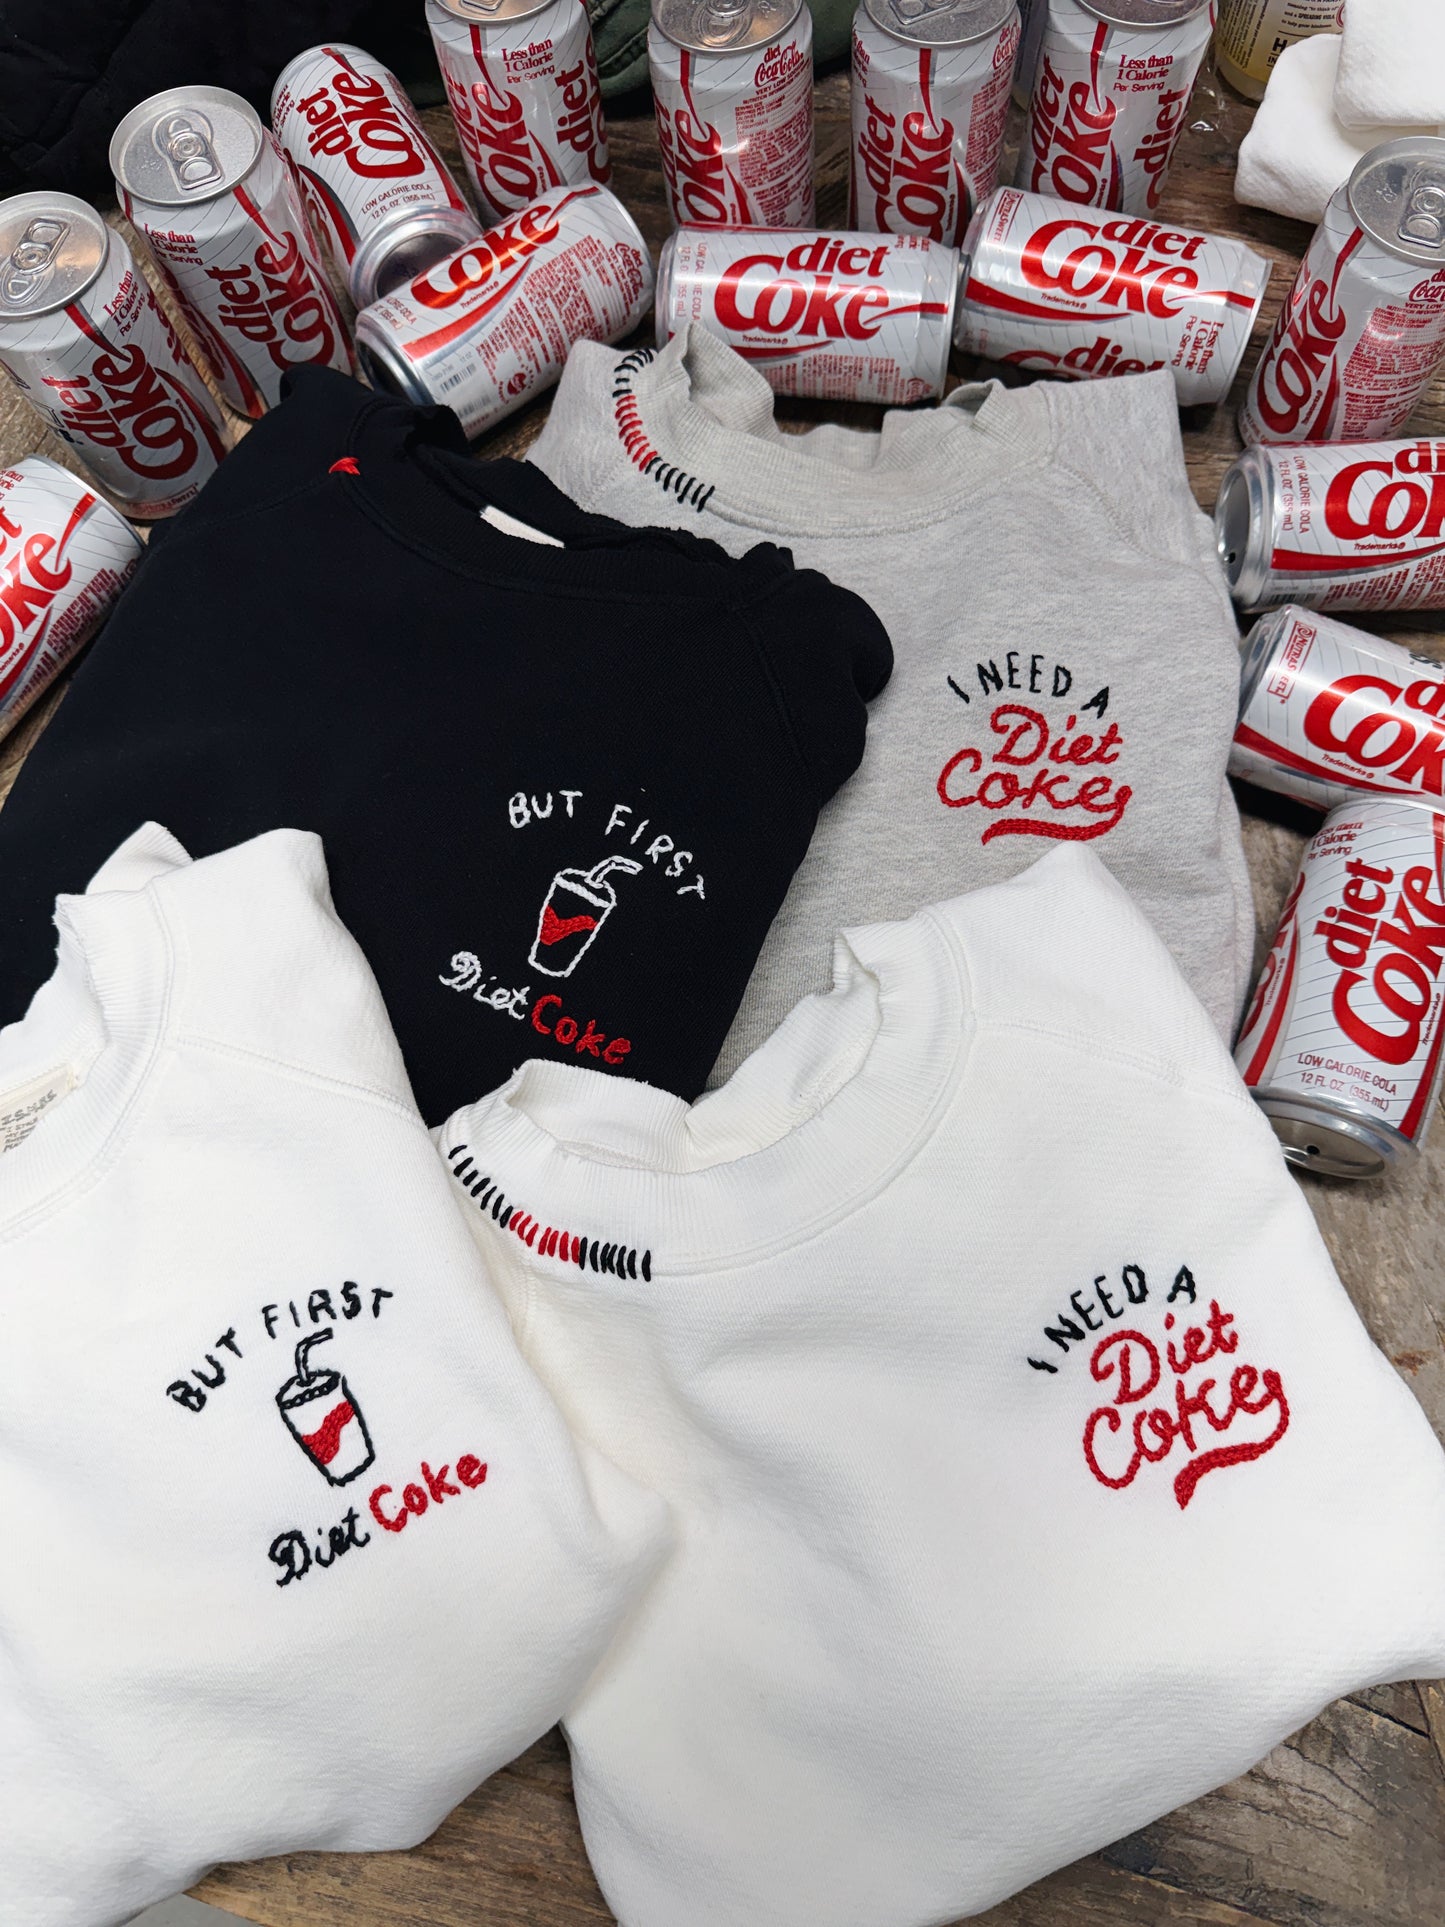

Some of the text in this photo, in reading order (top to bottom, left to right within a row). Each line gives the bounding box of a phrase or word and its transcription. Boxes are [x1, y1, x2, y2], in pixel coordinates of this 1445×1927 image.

[502, 39, 553, 63] Less than
[505, 51, 554, 73] 1 Calorie
[507, 64, 556, 84] Per Serving
[764, 43, 781, 64] diet
[1116, 67, 1169, 81] 1 Calorie
[1119, 54, 1173, 69] Less than
[557, 60, 593, 154] diet
[1113, 81, 1165, 92] Per Serving
[296, 88, 353, 158] diet
[332, 72, 425, 179] Coke
[858, 94, 897, 192] diet
[1133, 83, 1189, 174] diet
[362, 184, 432, 214] LOW CALORIE COLA
[371, 211, 380, 219] 12
[144, 223, 196, 243] Less than
[157, 239, 199, 254] Calorie
[171, 253, 204, 266] Serving
[410, 204, 560, 309] Coke
[787, 237, 891, 278] diet
[1091, 217, 1208, 261] diet
[103, 270, 134, 318] Less than
[118, 281, 139, 321] Calorie
[692, 259, 705, 295] CALIE
[714, 254, 890, 341] Coke
[1020, 219, 1199, 319] Coke
[119, 321, 132, 337] Per
[207, 264, 274, 343] diet
[255, 231, 335, 373] Coke
[692, 298, 705, 320] COLA
[1185, 327, 1209, 370] Calorie
[1197, 320, 1224, 374] Less than
[1256, 279, 1346, 424] Coke
[41, 374, 127, 448] diet
[92, 344, 199, 480] Coke
[1394, 441, 1445, 474] di
[1294, 456, 1311, 534] LOW CALORIE COLA
[1324, 461, 1445, 541] Cok
[0, 533, 72, 658] ke
[947, 651, 1110, 720] I NEED A
[1279, 636, 1310, 696] NUTRASEET
[990, 704, 1123, 766] Diet
[1303, 674, 1445, 797] Cok
[937, 748, 1133, 846] Coke
[508, 790, 706, 900] BUT FIRST
[1317, 830, 1357, 847] Calorie
[1319, 845, 1352, 857] Serving
[1313, 857, 1394, 969] diet
[1332, 865, 1445, 1066] Coke
[438, 950, 632, 1066] Diet Coke
[1297, 1052, 1398, 1096] LOW CALORIE COLA
[1301, 1072, 1390, 1113] 12 FL OZ (355 mL)
[166, 1280, 393, 1413] BUT FIRST
[1027, 1264, 1197, 1374] I NEED A
[1090, 1299, 1238, 1405] Diet
[1083, 1364, 1290, 1510] Coke
[268, 1453, 488, 1588] Diet Coke
